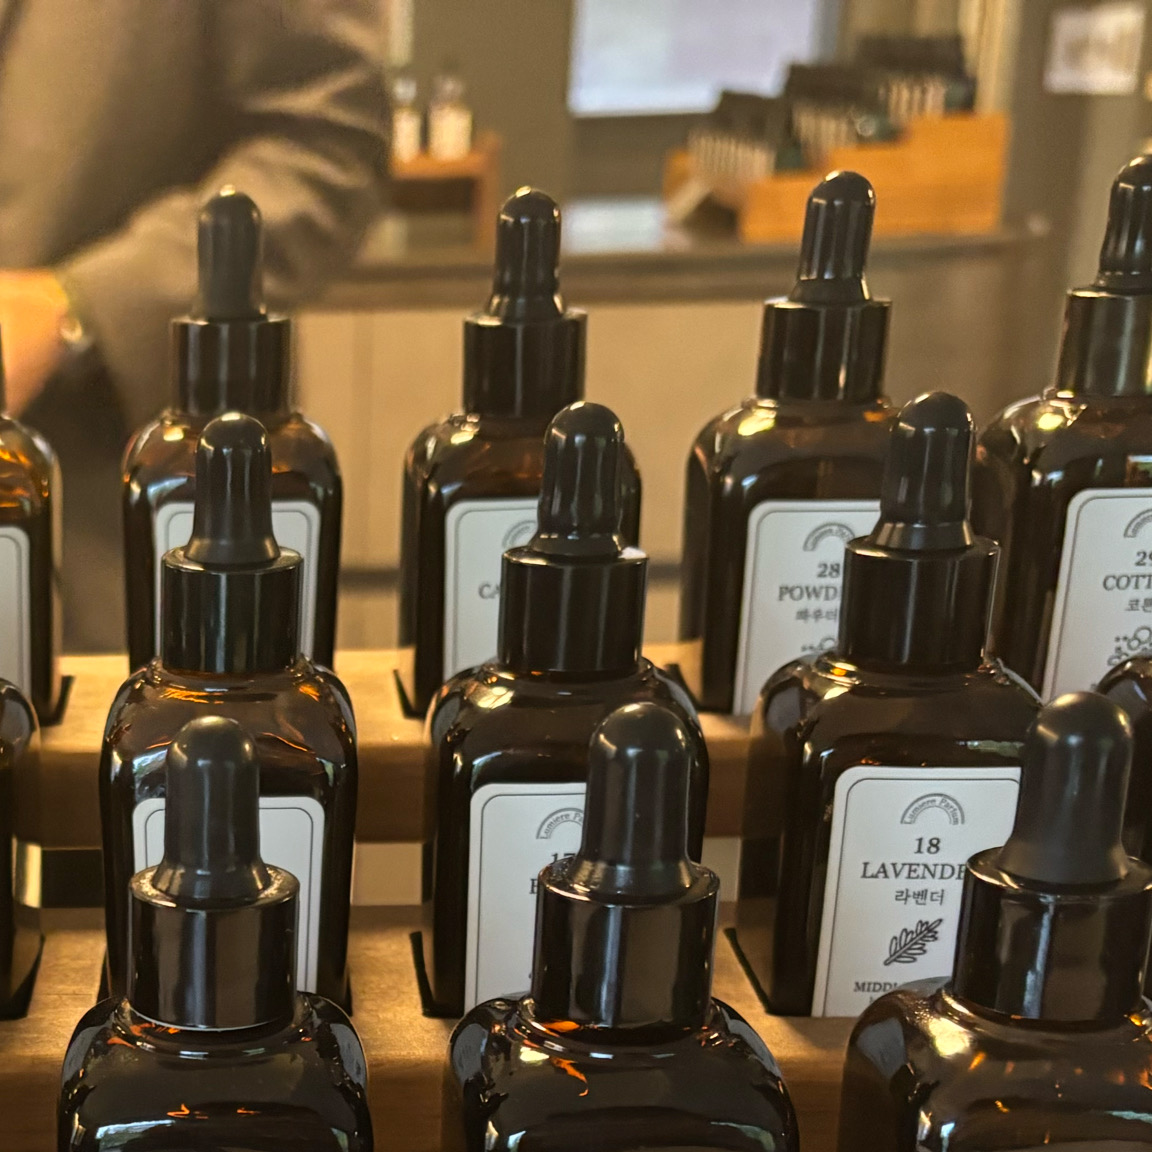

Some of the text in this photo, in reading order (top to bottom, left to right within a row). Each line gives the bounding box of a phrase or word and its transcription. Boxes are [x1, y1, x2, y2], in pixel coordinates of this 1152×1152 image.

[817, 563, 841, 579] 28
[1103, 574, 1152, 591] COTT
[778, 585, 838, 601] POWD
[914, 837, 941, 854] 18
[861, 862, 965, 880] LAVENDE
[895, 888, 944, 906] 라벤더
